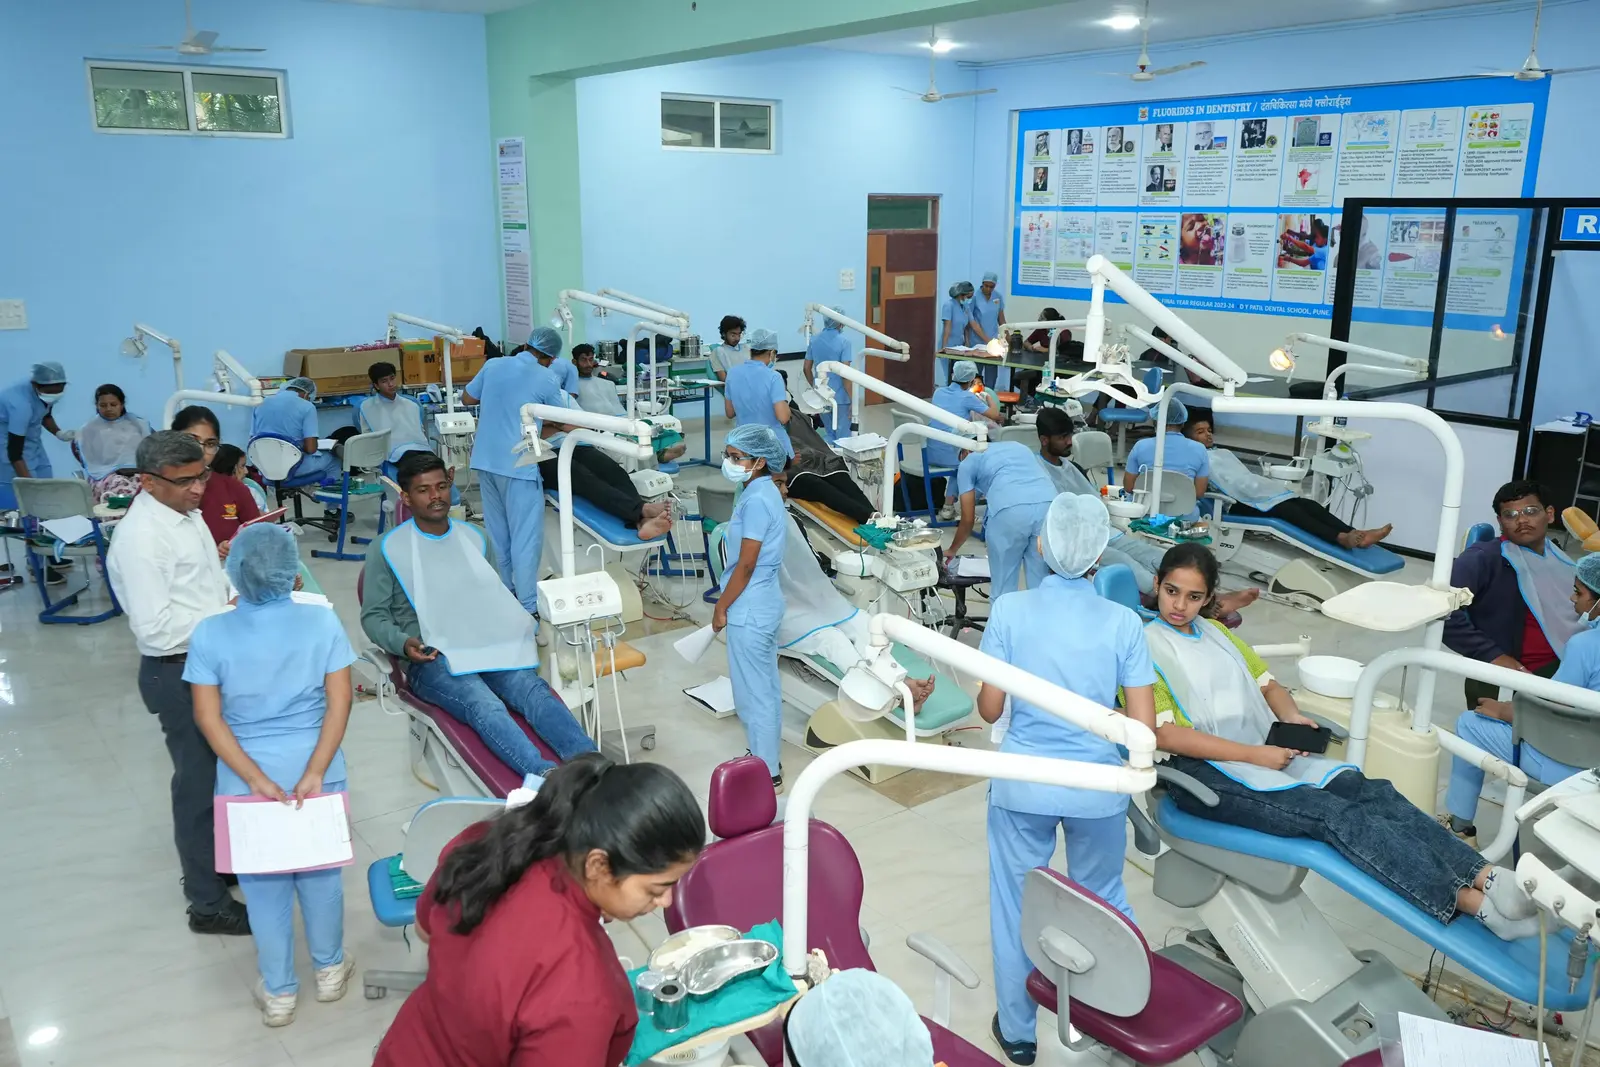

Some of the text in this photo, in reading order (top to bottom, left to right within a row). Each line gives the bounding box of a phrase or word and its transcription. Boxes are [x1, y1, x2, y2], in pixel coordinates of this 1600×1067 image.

[1153, 106, 1194, 117] FLUORIDES
[1207, 102, 1251, 113] DENTISTRY
[1576, 214, 1600, 234] R
